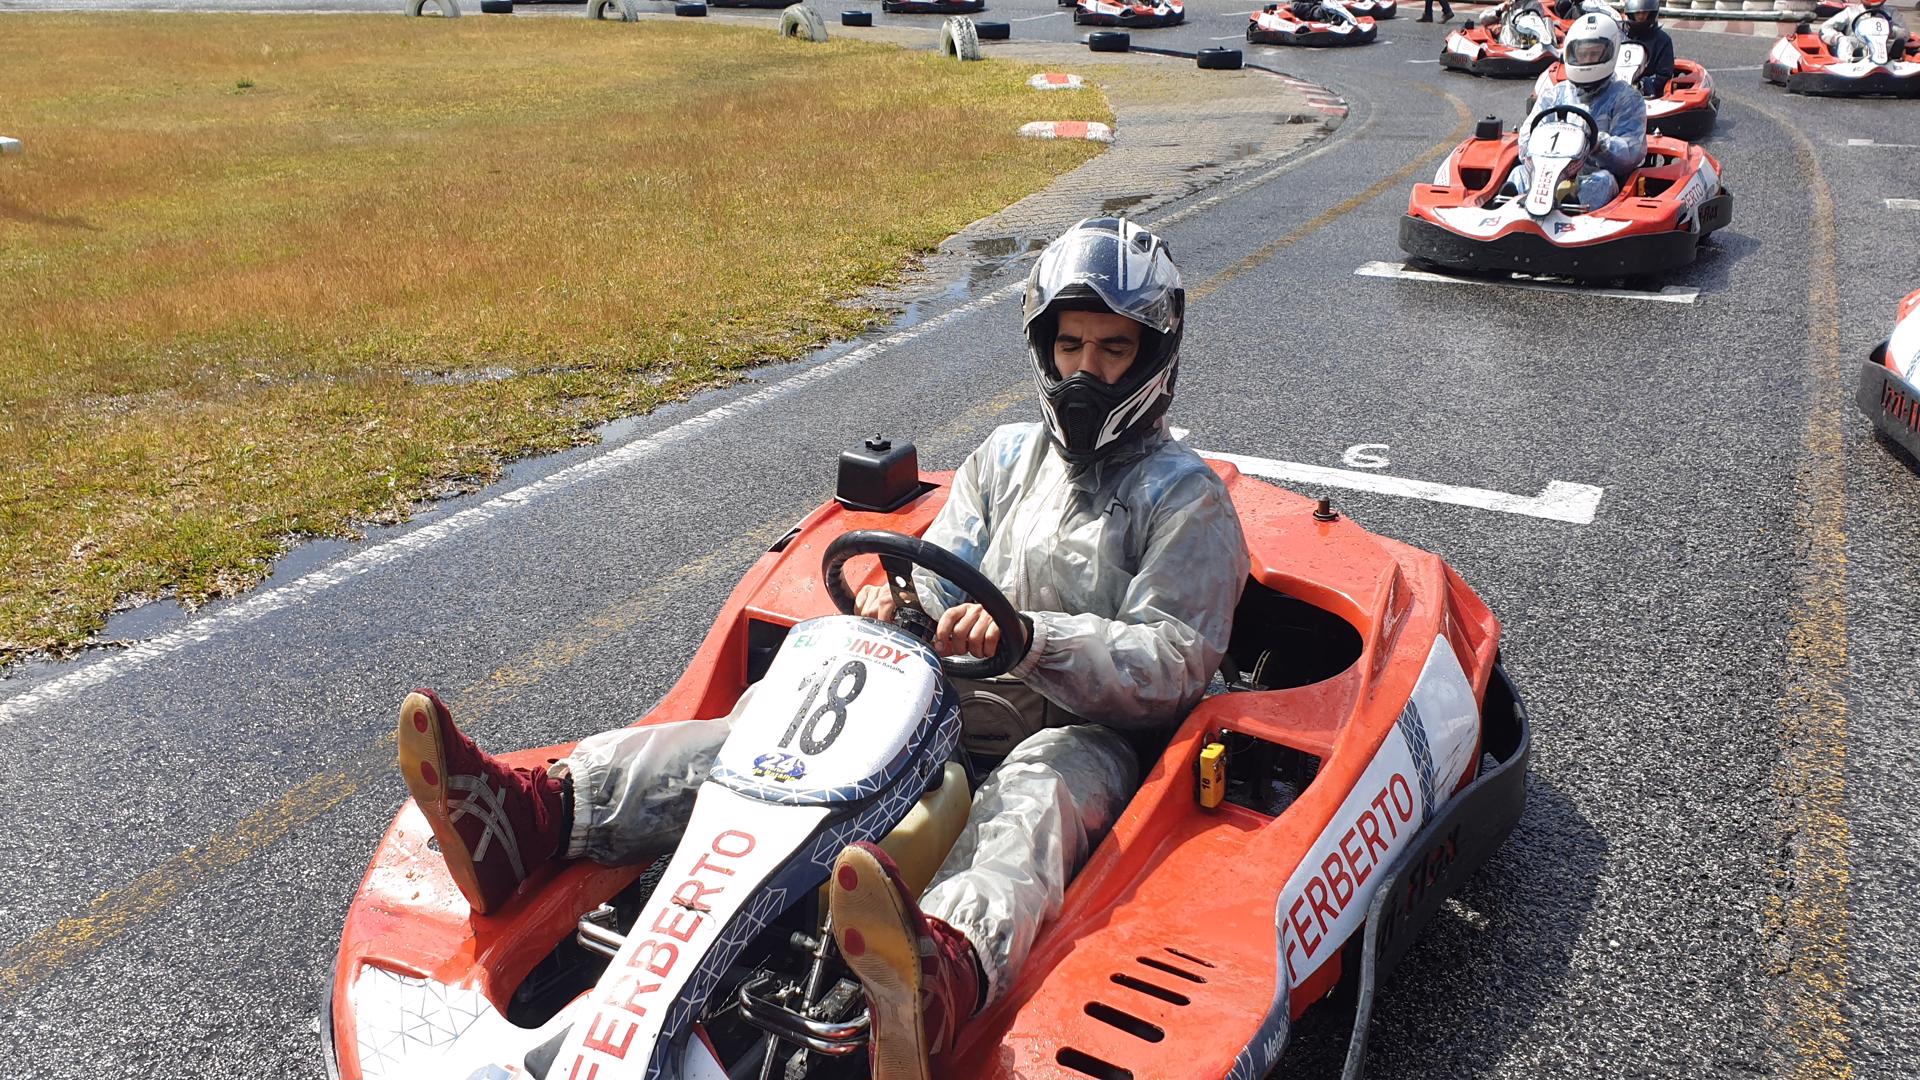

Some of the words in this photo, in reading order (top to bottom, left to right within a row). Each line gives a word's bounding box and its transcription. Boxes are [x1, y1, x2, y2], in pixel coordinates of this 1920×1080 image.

[1875, 21, 1883, 32] 8
[1624, 49, 1632, 63] 9
[1550, 131, 1560, 152] 1
[793, 634, 911, 665] EUINDY
[777, 656, 867, 756] 18
[1281, 773, 1414, 983] FERBERTO
